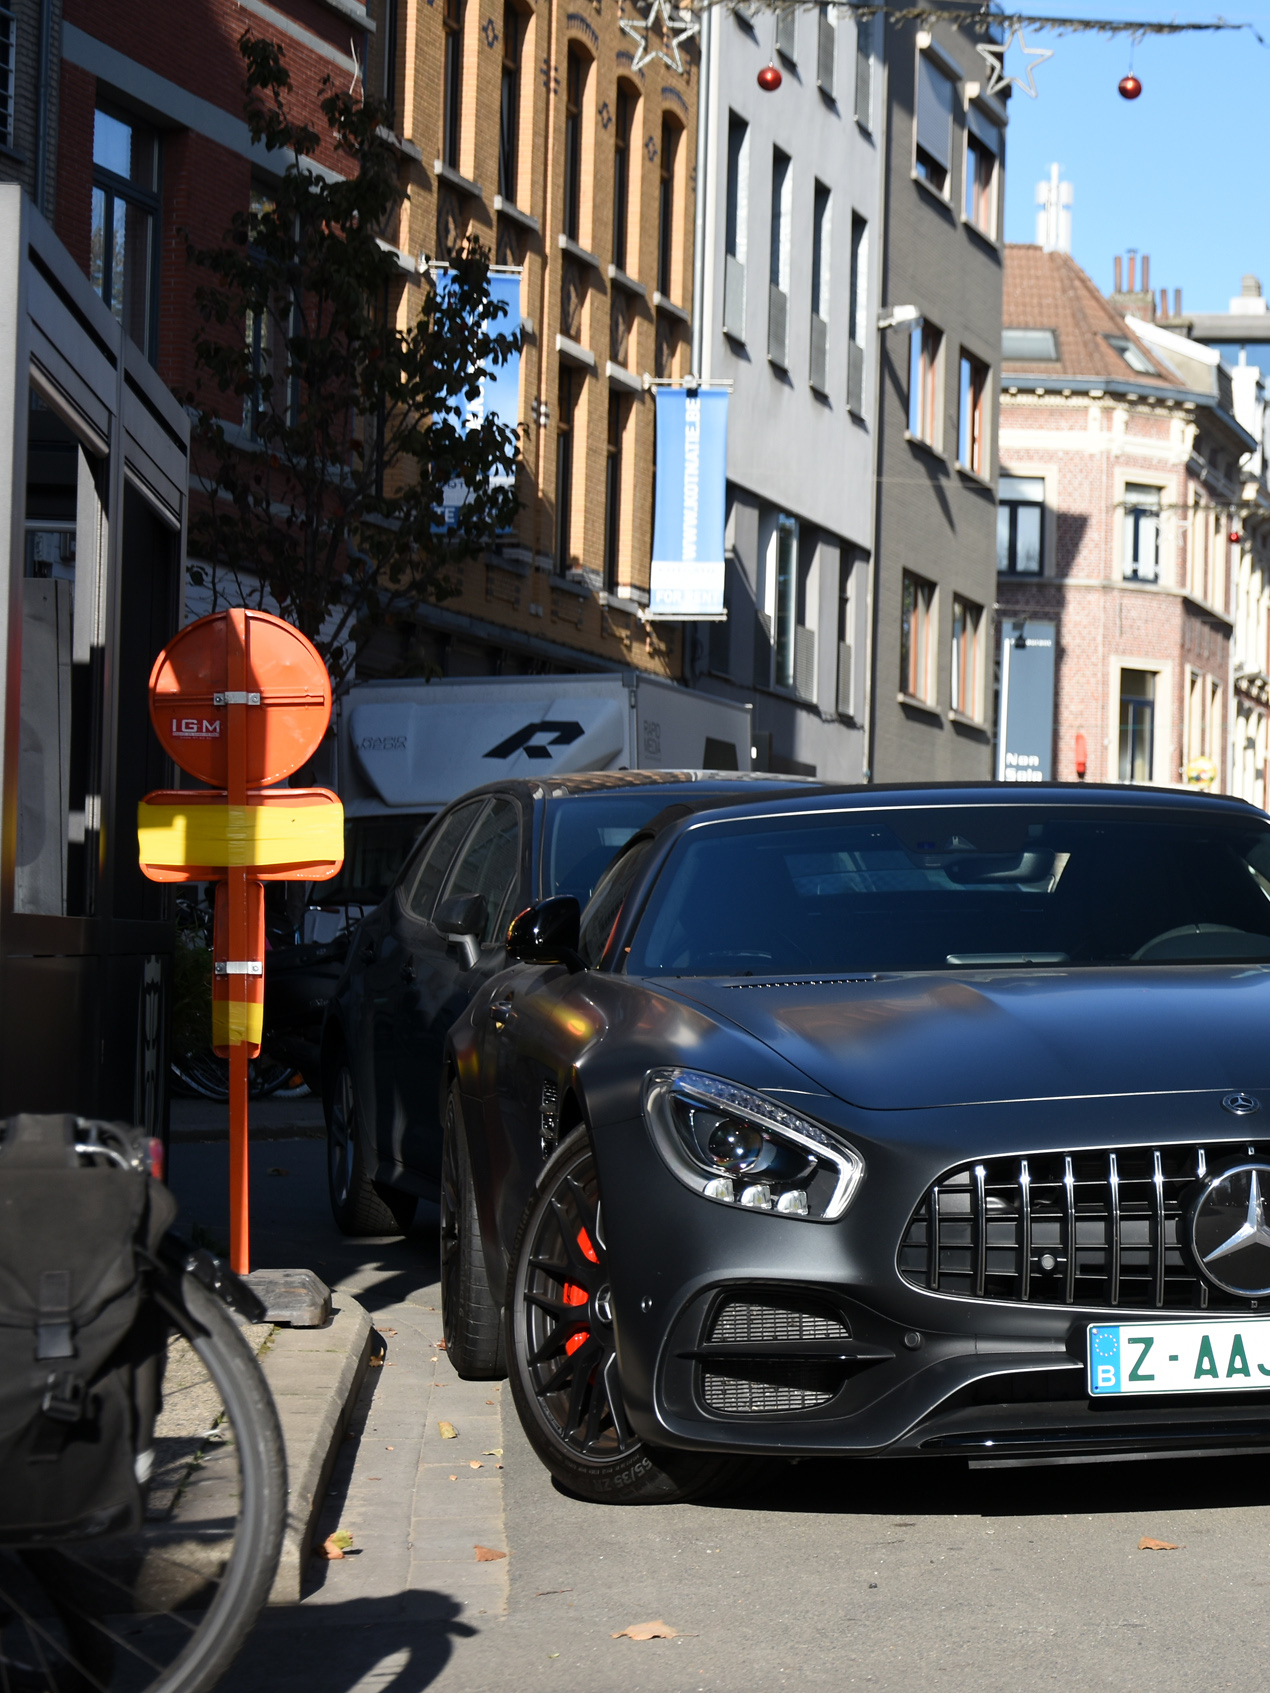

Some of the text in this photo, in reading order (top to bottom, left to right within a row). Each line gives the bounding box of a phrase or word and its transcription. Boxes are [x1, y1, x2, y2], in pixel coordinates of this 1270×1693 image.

[682, 397, 701, 561] WWW.KOTNATIE.BE
[656, 590, 682, 604] FOR
[172, 719, 220, 733] IGM
[1097, 1364, 1116, 1387] B
